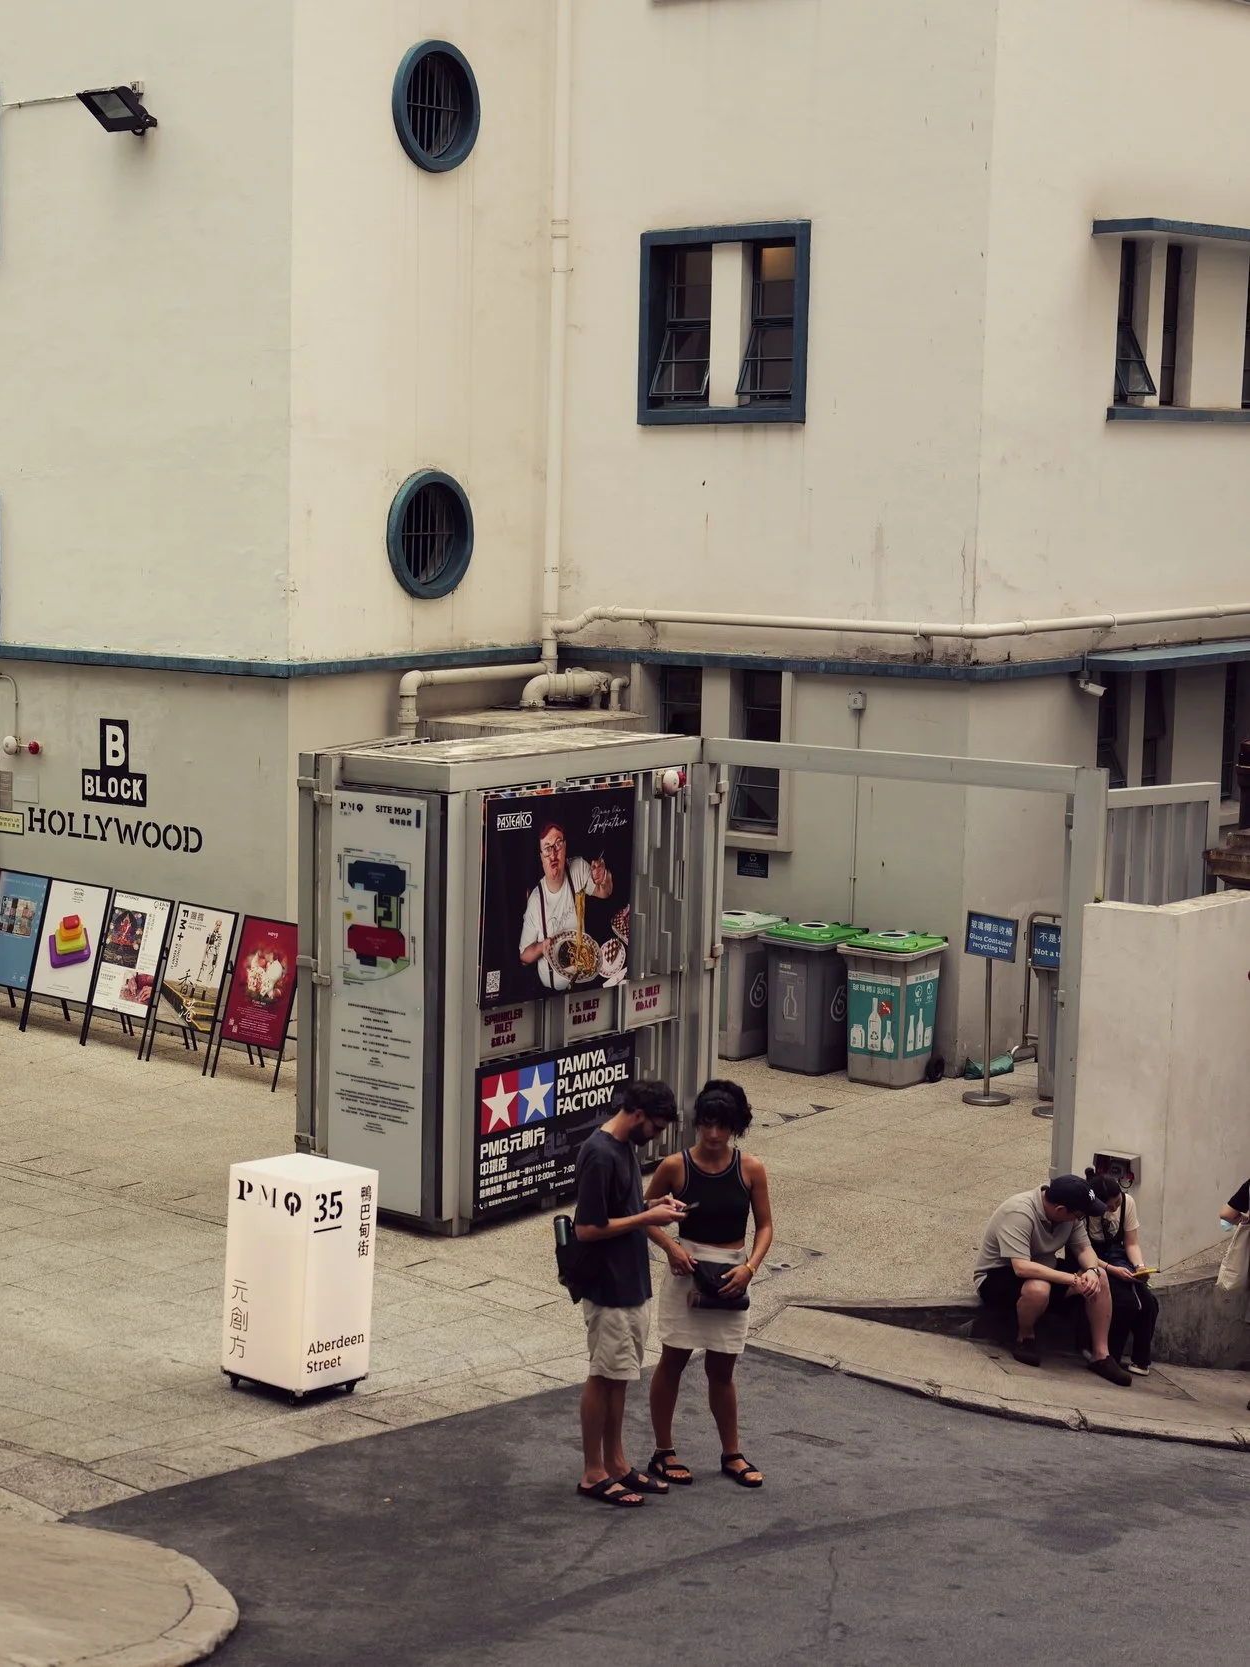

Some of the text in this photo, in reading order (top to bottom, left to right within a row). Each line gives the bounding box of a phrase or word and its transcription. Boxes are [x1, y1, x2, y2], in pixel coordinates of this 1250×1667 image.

[105, 724, 126, 767] B
[84, 775, 144, 801] BLOCK
[340, 801, 412, 816] PMQ SITE MAP
[497, 811, 532, 831] PASTEAKO
[28, 807, 203, 853] HOLLYWOOD
[969, 932, 1013, 948] Glass Container
[972, 941, 1008, 954] recycling bin
[1034, 948, 1048, 957] Not
[485, 1008, 523, 1027] SPRINKLER
[494, 1021, 513, 1035] INLET
[556, 1048, 607, 1076] TAMIYA
[557, 1062, 629, 1097] PLAMODEL
[555, 1085, 615, 1117] FACTORY
[480, 1126, 546, 1160] PMQ元創方
[236, 1178, 302, 1217] PMQ
[313, 1190, 343, 1223] 35
[357, 1184, 372, 1258] 鴨巴甸街
[229, 1279, 249, 1359] 元創方
[307, 1332, 365, 1357] Aberdeen
[306, 1355, 342, 1374] Street
